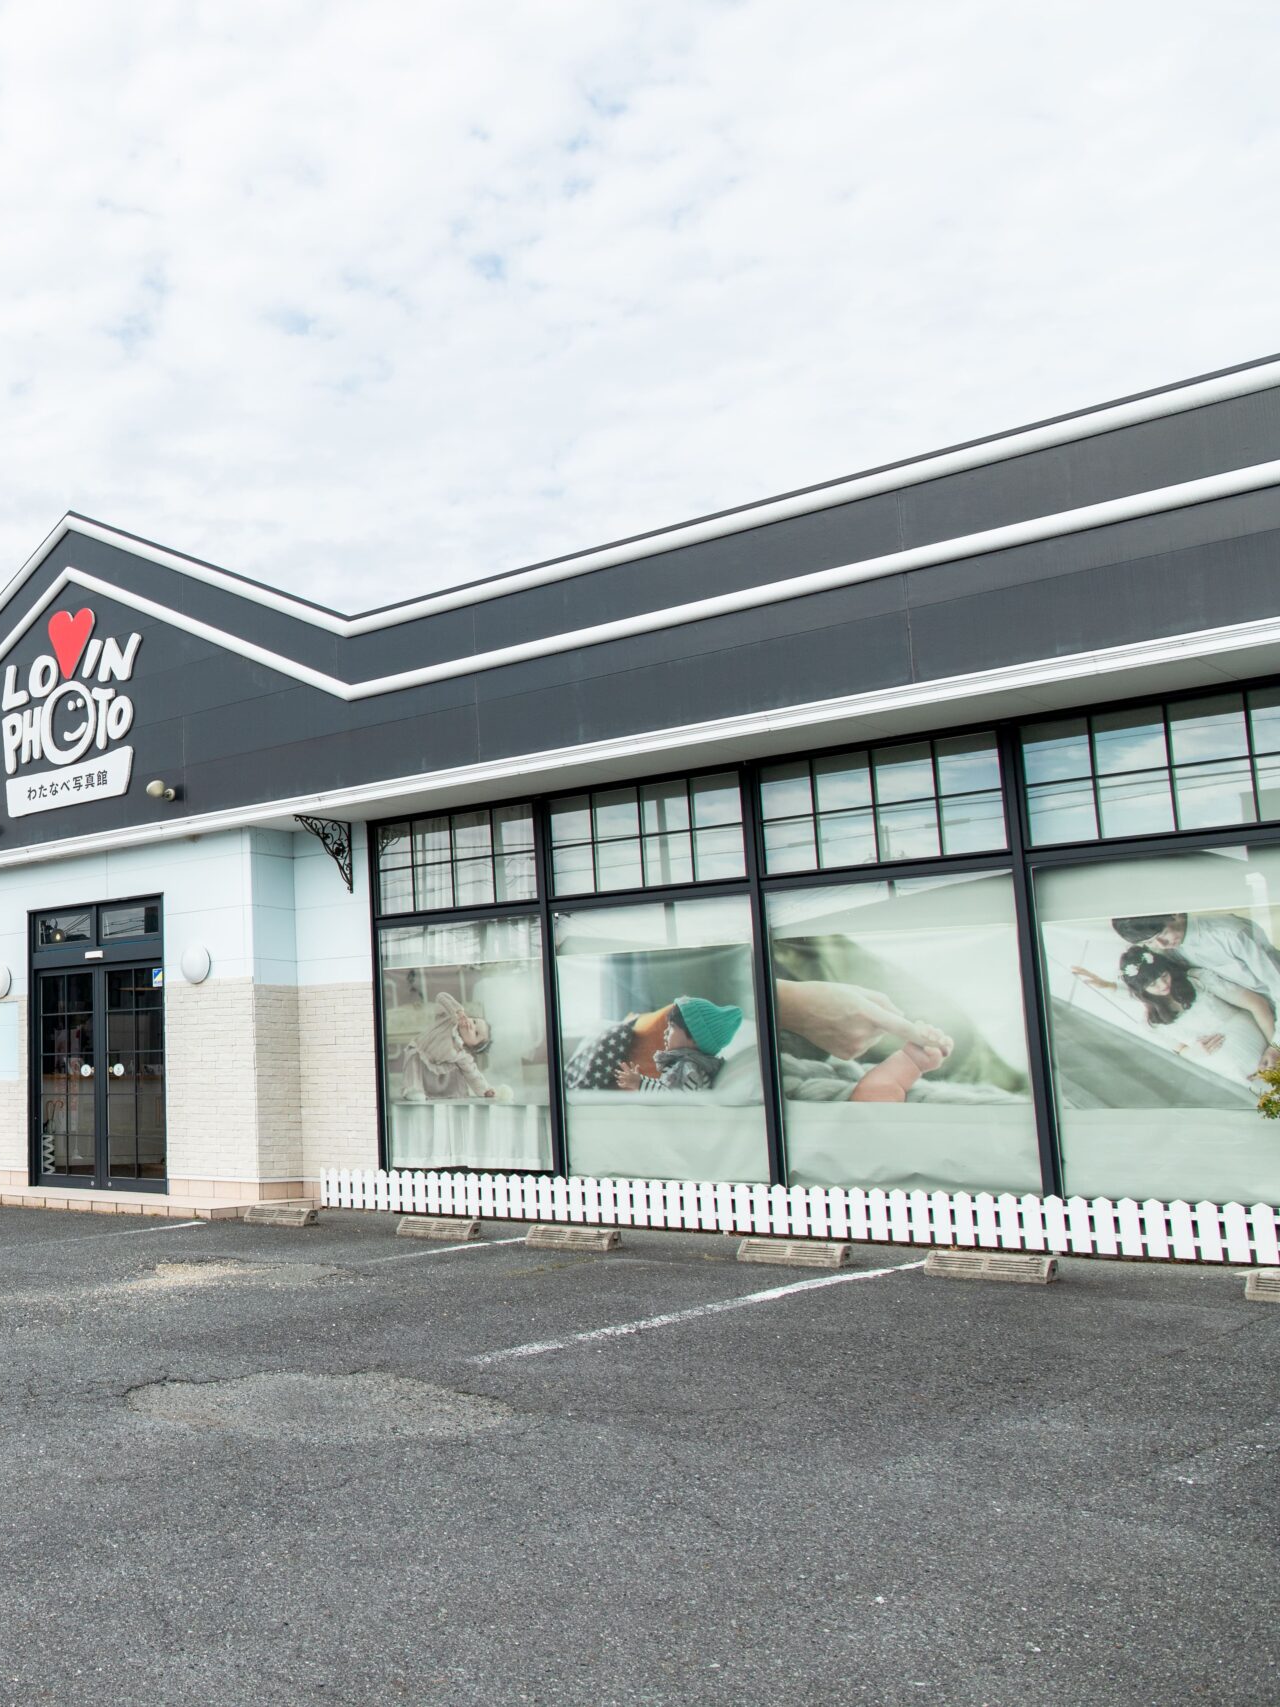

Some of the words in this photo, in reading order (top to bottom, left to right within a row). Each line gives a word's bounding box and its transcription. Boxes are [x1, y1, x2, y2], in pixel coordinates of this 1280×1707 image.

[2, 681, 133, 774] PHOTO
[27, 769, 108, 801] わたなべ写真館
